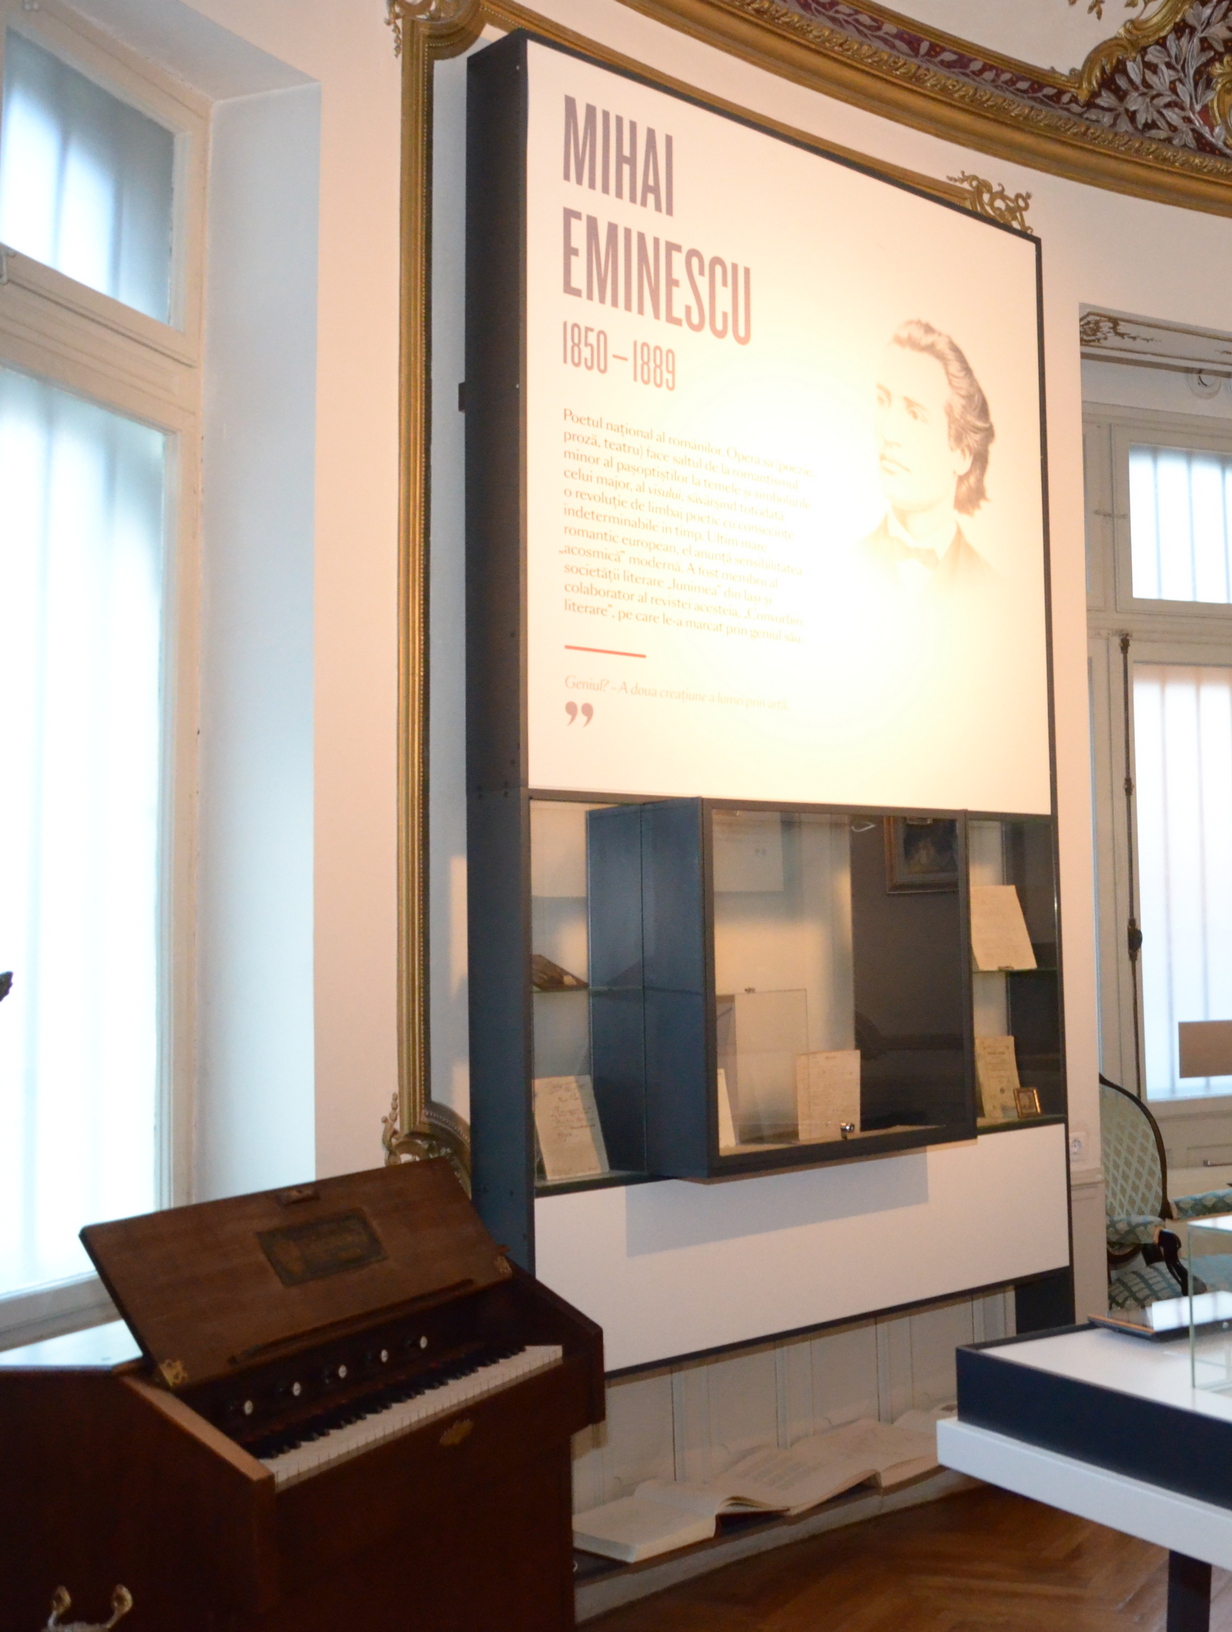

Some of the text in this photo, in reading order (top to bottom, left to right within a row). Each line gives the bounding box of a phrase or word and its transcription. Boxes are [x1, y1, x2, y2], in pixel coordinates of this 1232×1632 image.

[562, 94, 674, 217] MIHAI
[562, 206, 752, 346] EMINESCU
[563, 408, 603, 429] Poetul
[656, 431, 666, 443] al
[726, 446, 761, 464] Opera
[563, 448, 601, 465] minor
[603, 456, 614, 468] al
[692, 473, 701, 486] la
[703, 478, 741, 496] temele
[604, 438, 644, 459] teatru)
[646, 446, 670, 462] face
[672, 453, 703, 470] saltul
[705, 460, 718, 473] de
[721, 462, 731, 475] la
[563, 467, 594, 483] celui
[596, 475, 633, 491] major,
[635, 481, 645, 494] al
[563, 487, 573, 498] o
[630, 498, 646, 512] de
[648, 500, 683, 520] limbaj
[685, 511, 719, 527] poetic
[722, 519, 736, 530] cu
[563, 502, 659, 533] indeterminabile
[563, 525, 619, 544] romantic
[621, 535, 680, 556] european,
[682, 543, 693, 556] el
[622, 569, 665, 588] literare
[723, 585, 742, 599] din
[687, 562, 697, 575] A
[698, 563, 720, 580] fost
[563, 580, 636, 601] colaborator
[637, 591, 648, 604] al
[650, 593, 692, 611] revistei
[617, 609, 633, 621] pe
[635, 611, 660, 624] care
[662, 612, 683, 627] le-a
[685, 619, 724, 633] marcat
[564, 674, 610, 692] Geniul?
[630, 683, 658, 698] doua
